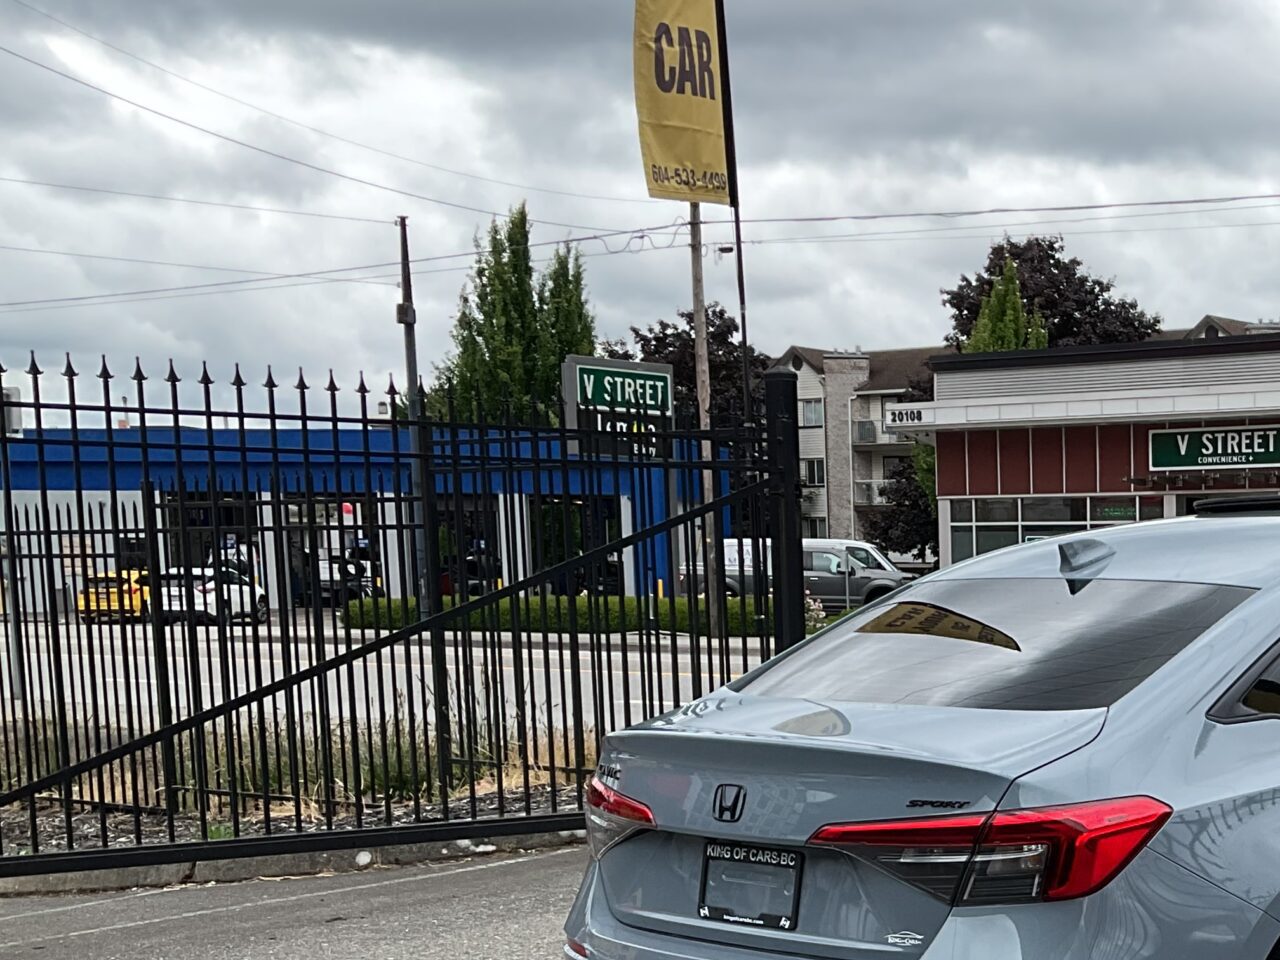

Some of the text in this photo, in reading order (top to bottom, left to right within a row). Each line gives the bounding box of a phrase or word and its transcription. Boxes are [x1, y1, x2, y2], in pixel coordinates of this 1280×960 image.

[653, 22, 716, 100] CAR
[583, 373, 665, 406] V STREET
[891, 410, 922, 423] 20108
[1176, 430, 1278, 456] V STREET
[1198, 455, 1247, 464] CONVENIENCE
[905, 799, 971, 809] SPORT
[706, 844, 796, 866] KING OF CARS BC
